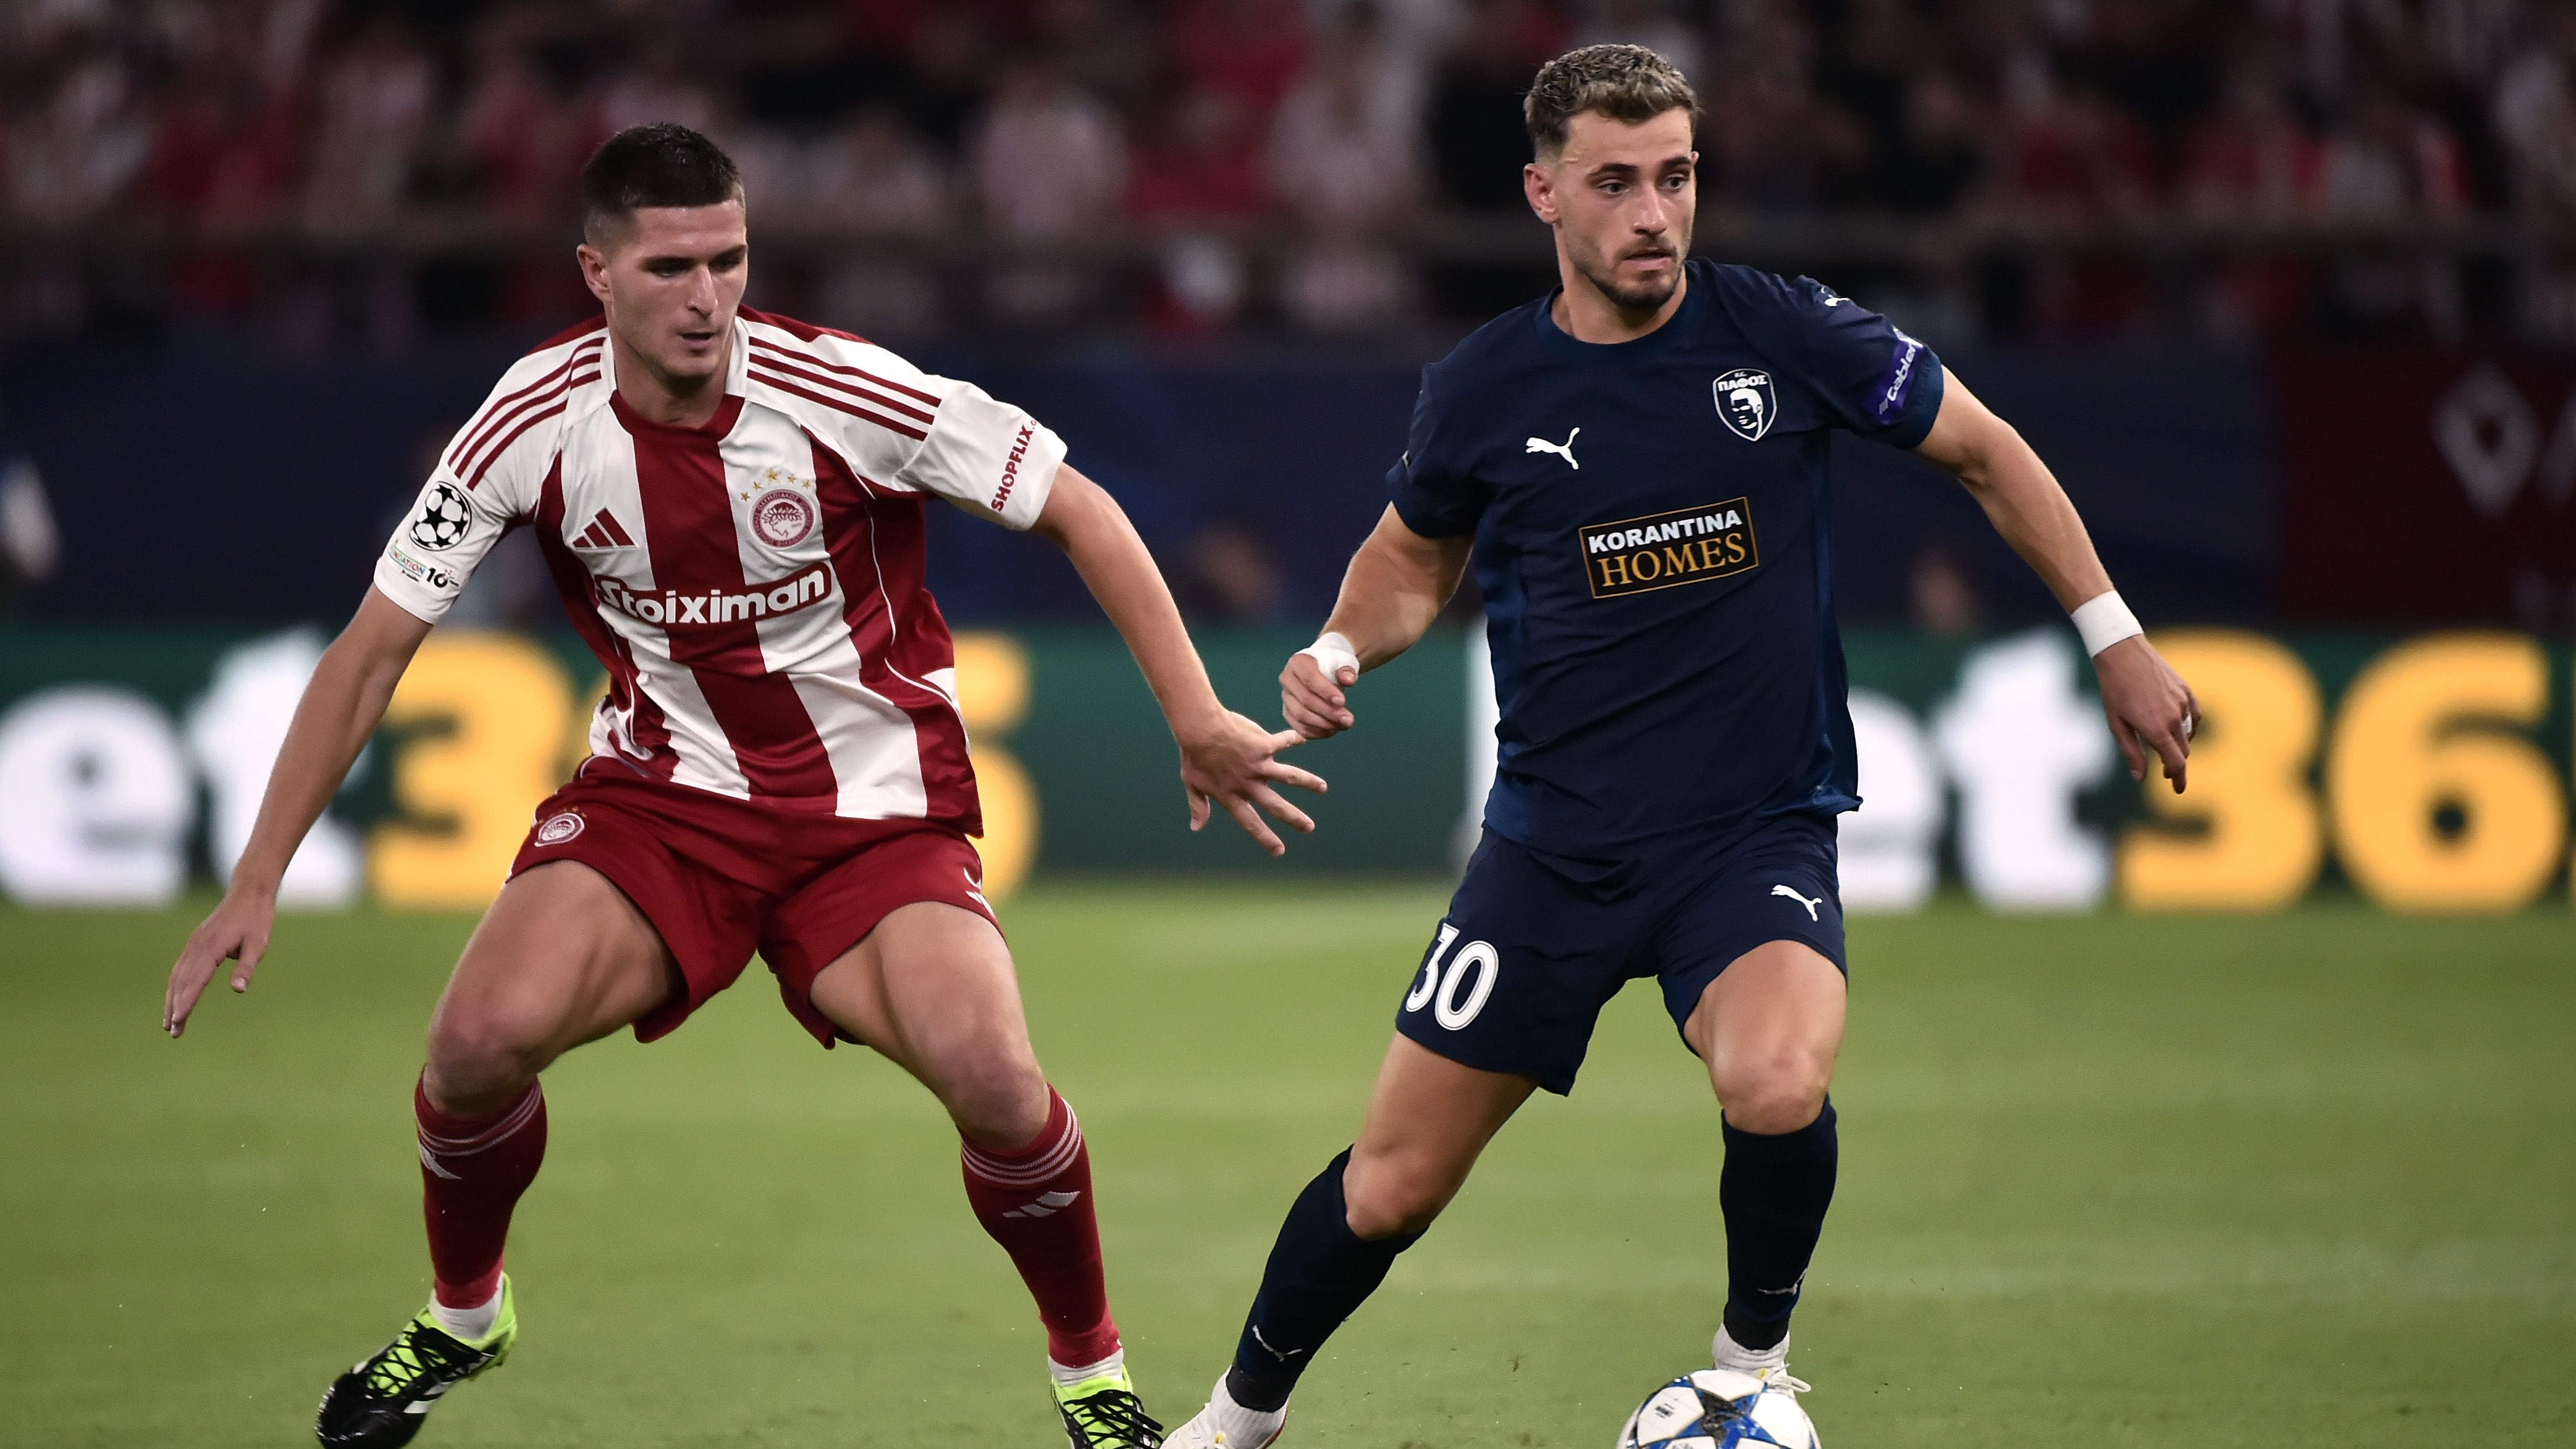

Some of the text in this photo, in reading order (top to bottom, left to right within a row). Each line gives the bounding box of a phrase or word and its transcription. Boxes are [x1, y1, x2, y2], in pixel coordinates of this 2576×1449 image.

[1718, 375, 1768, 392] ΠΑΦΟΣ
[1588, 510, 1743, 553] KORANTINA
[1597, 532, 1746, 587] HOMES
[600, 569, 825, 624] Stoiximan
[1405, 923, 1499, 1031] 30
